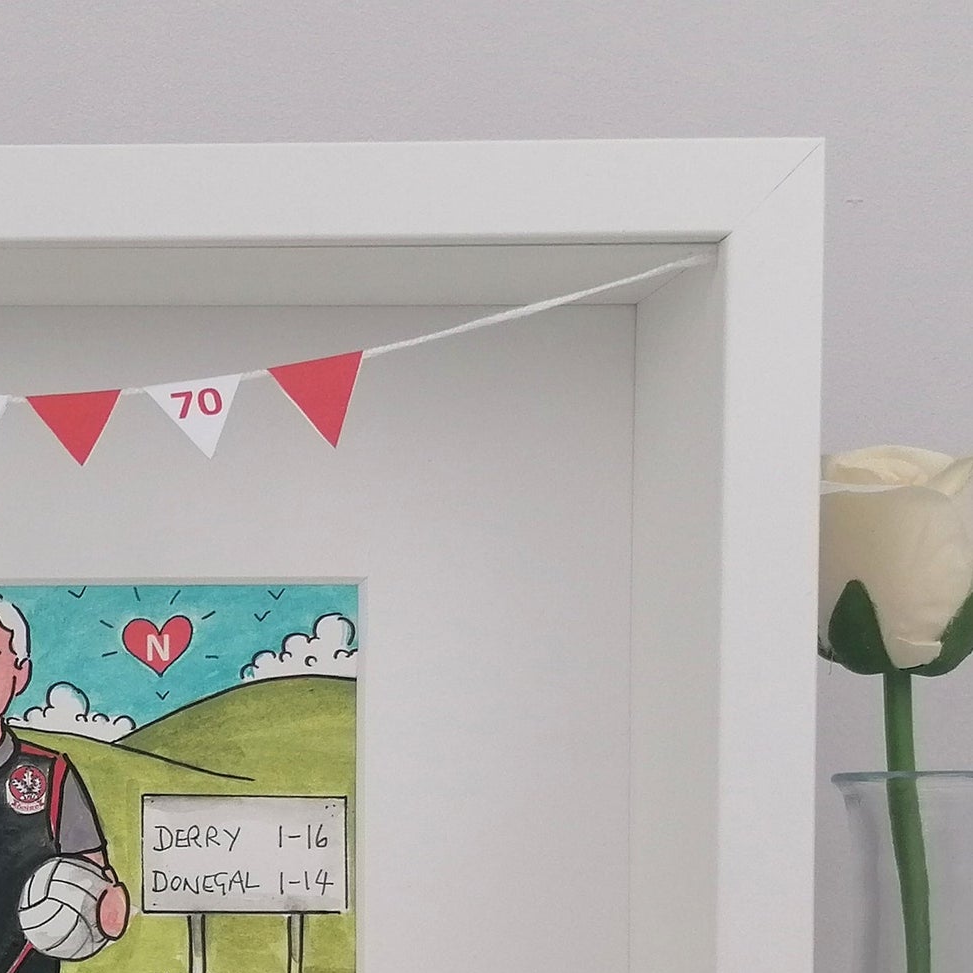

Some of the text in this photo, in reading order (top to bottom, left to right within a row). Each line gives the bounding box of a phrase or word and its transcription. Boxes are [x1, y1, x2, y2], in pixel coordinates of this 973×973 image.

[170, 387, 223, 419] 70
[146, 633, 170, 662] N
[153, 824, 328, 852] DERRY 1-16
[152, 869, 334, 896] DONEGAL 1-14
